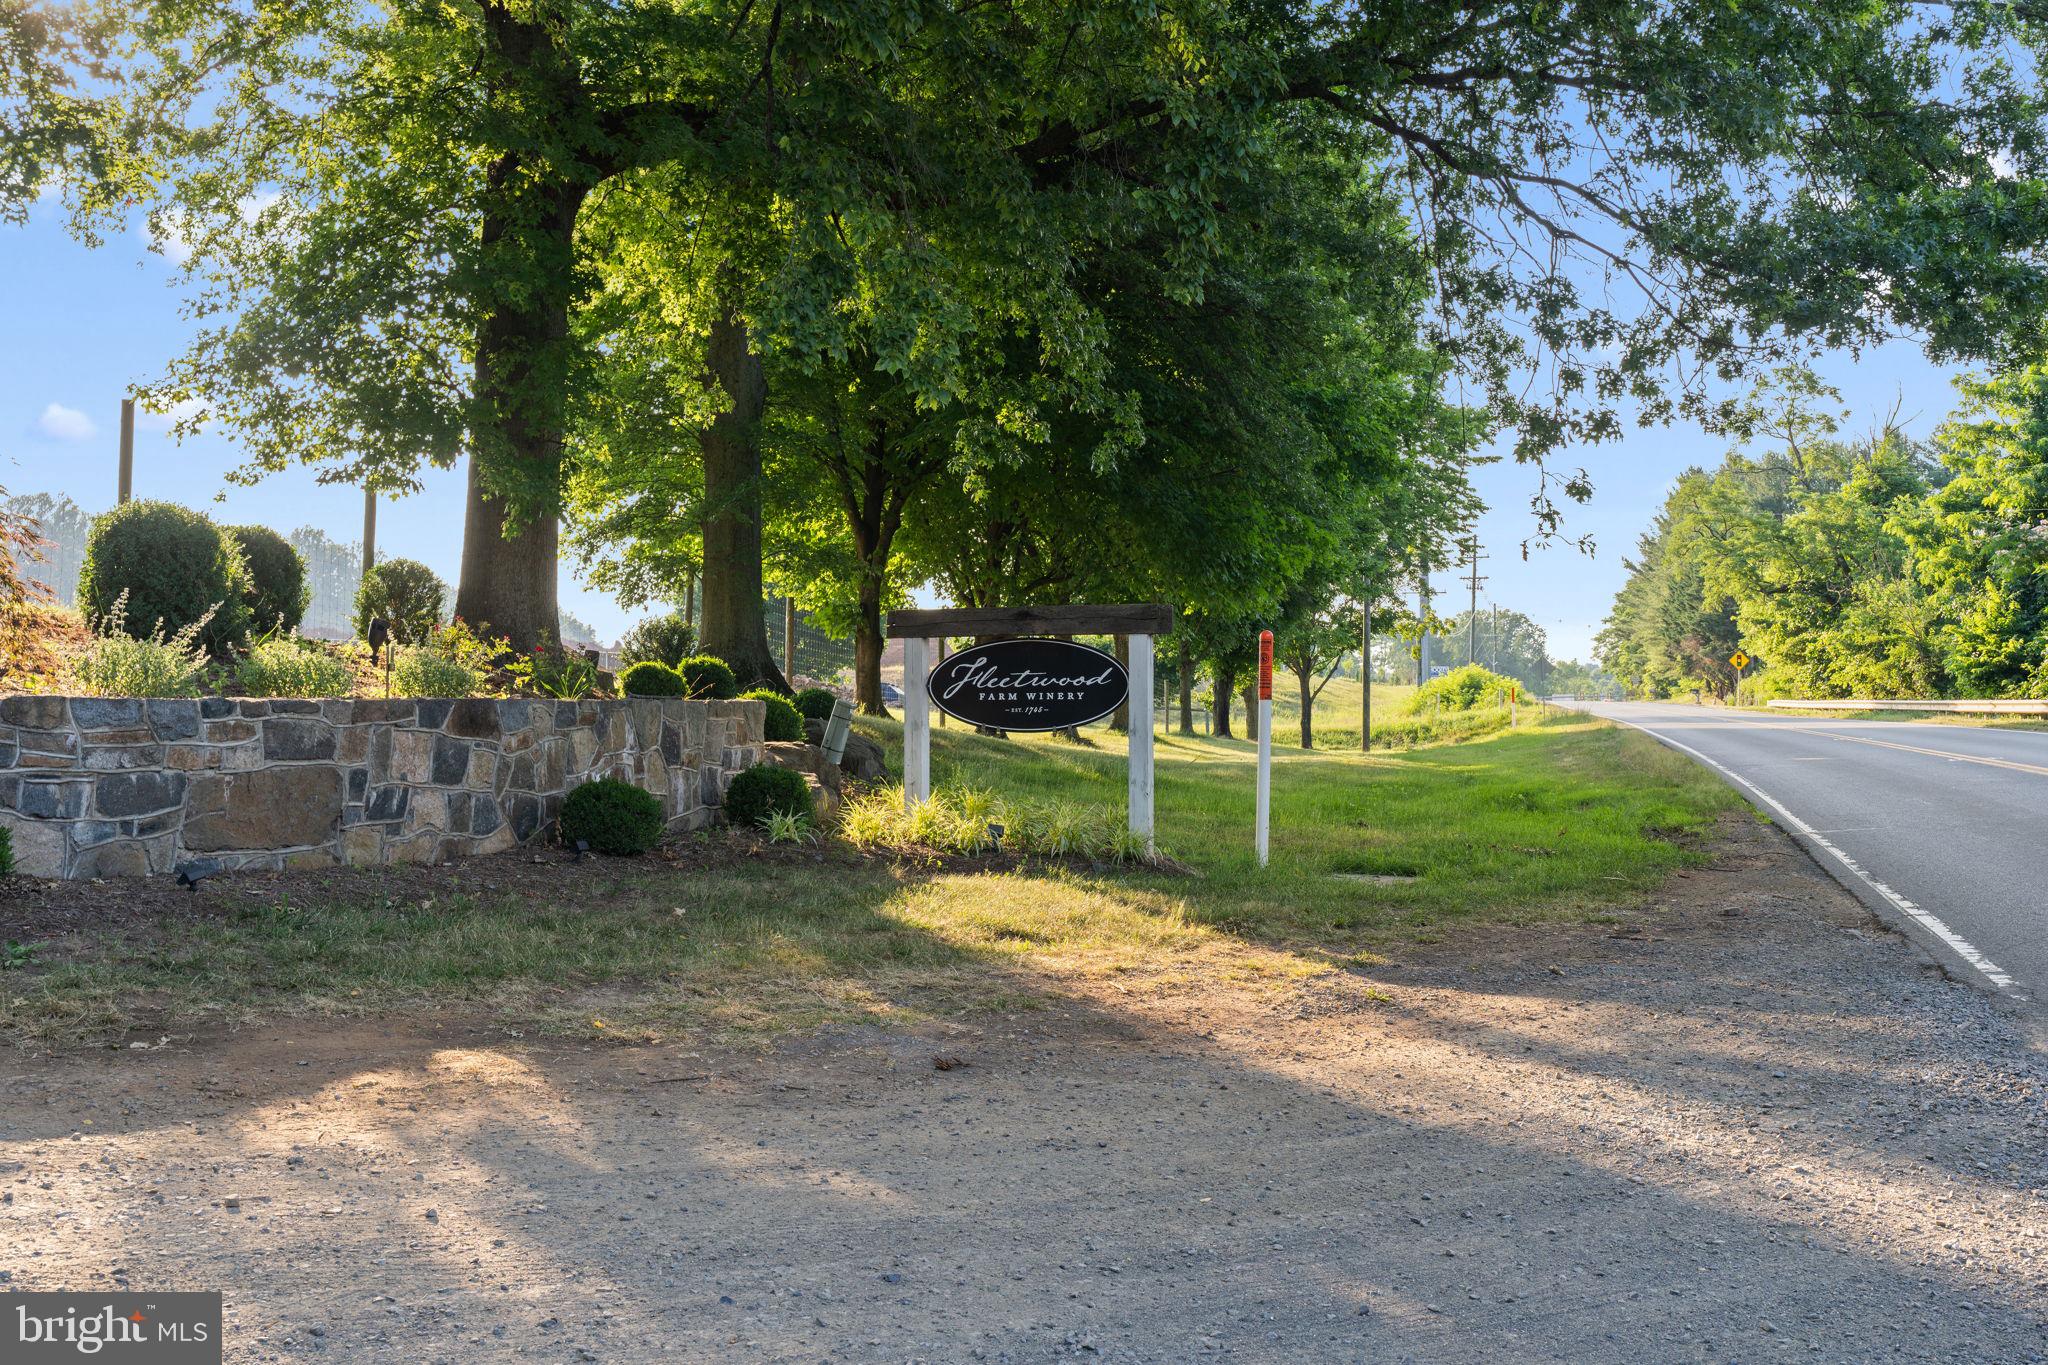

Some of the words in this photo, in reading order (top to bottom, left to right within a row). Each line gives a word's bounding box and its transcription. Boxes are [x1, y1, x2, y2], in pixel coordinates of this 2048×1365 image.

[943, 656, 1113, 699] Fleetwood
[979, 692, 1018, 700] FARM
[1026, 692, 1085, 700] WINERY
